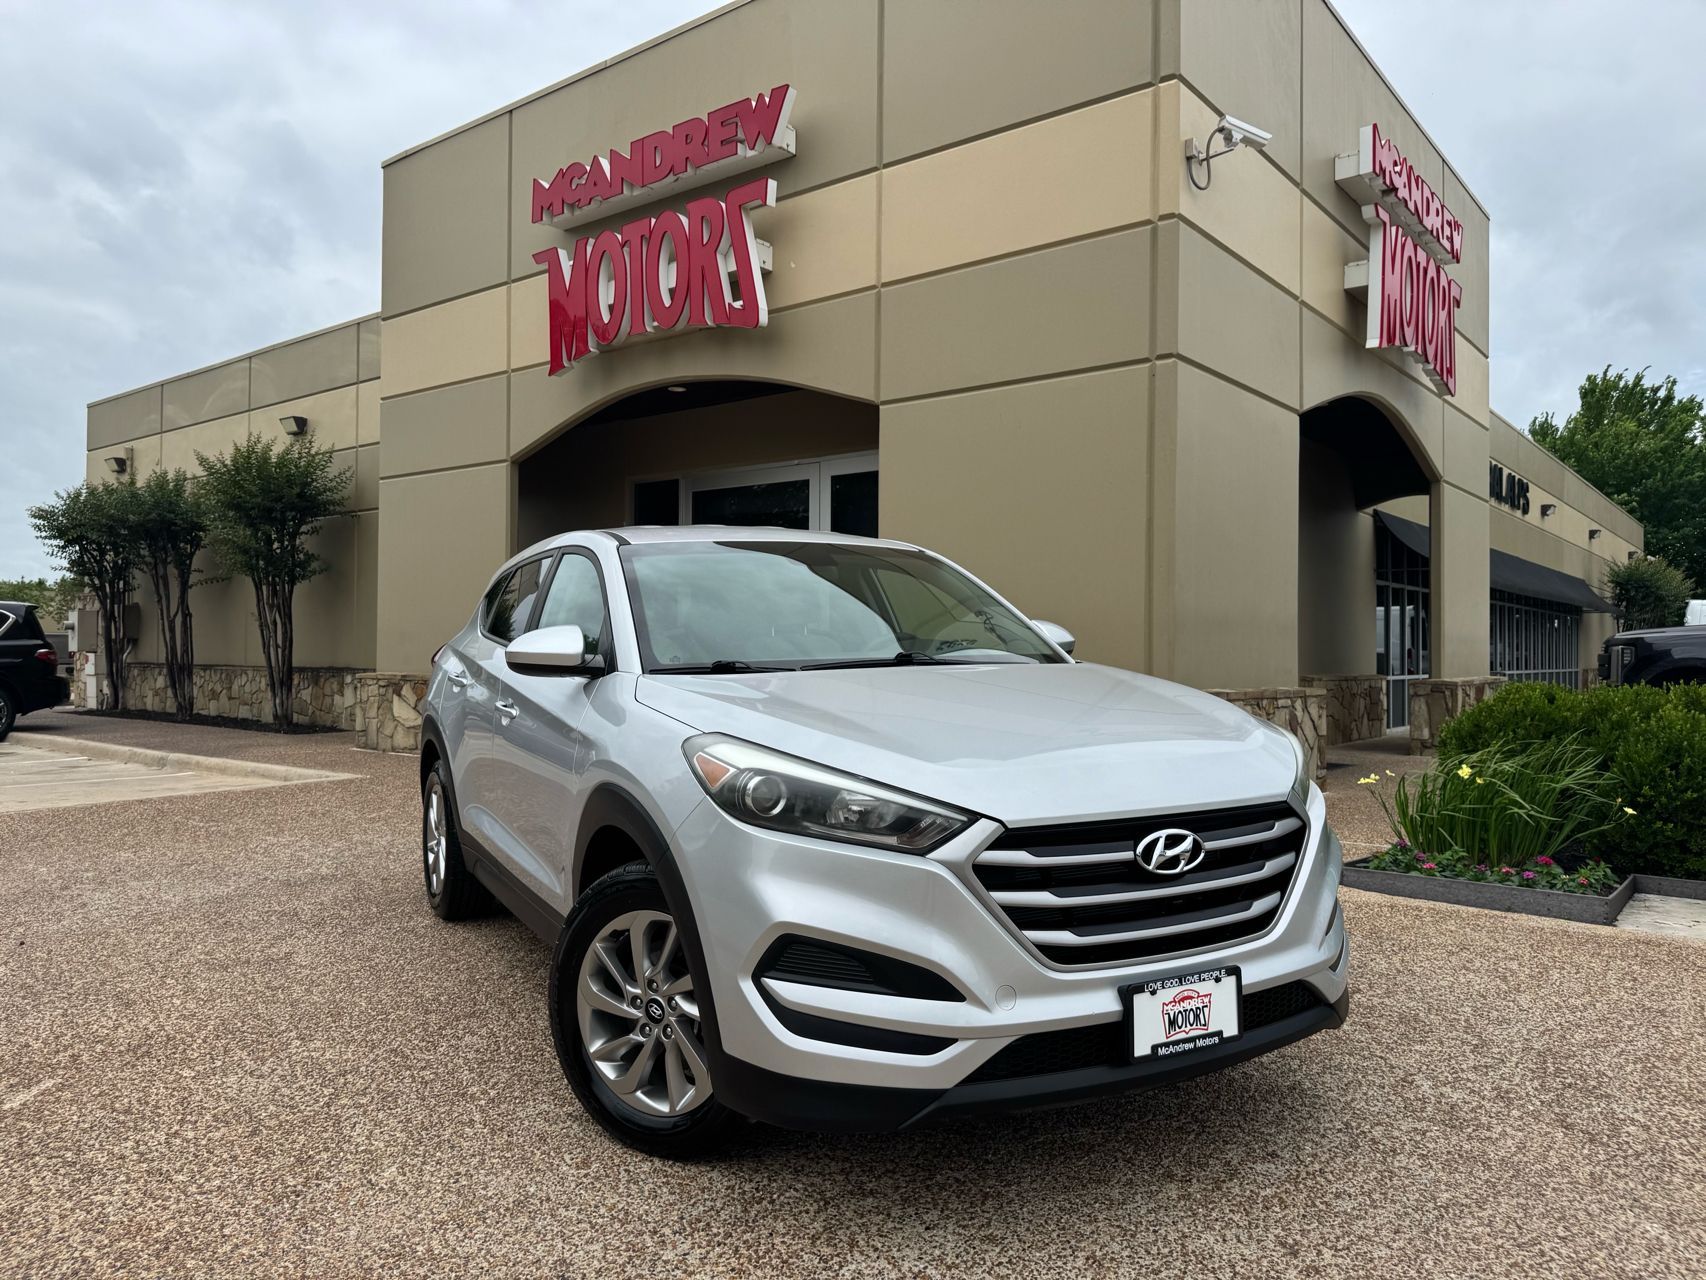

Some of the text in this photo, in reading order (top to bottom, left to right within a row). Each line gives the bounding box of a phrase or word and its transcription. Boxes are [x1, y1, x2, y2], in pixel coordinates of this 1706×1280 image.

[532, 177, 768, 376] MOTORS
[1375, 202, 1462, 397] MOTORS
[1144, 982, 1162, 992] LOVE
[1182, 974, 1200, 985] LOVE
[1165, 1005, 1208, 1035] MOTORS
[1158, 1035, 1219, 1056] McAndrew Motors
